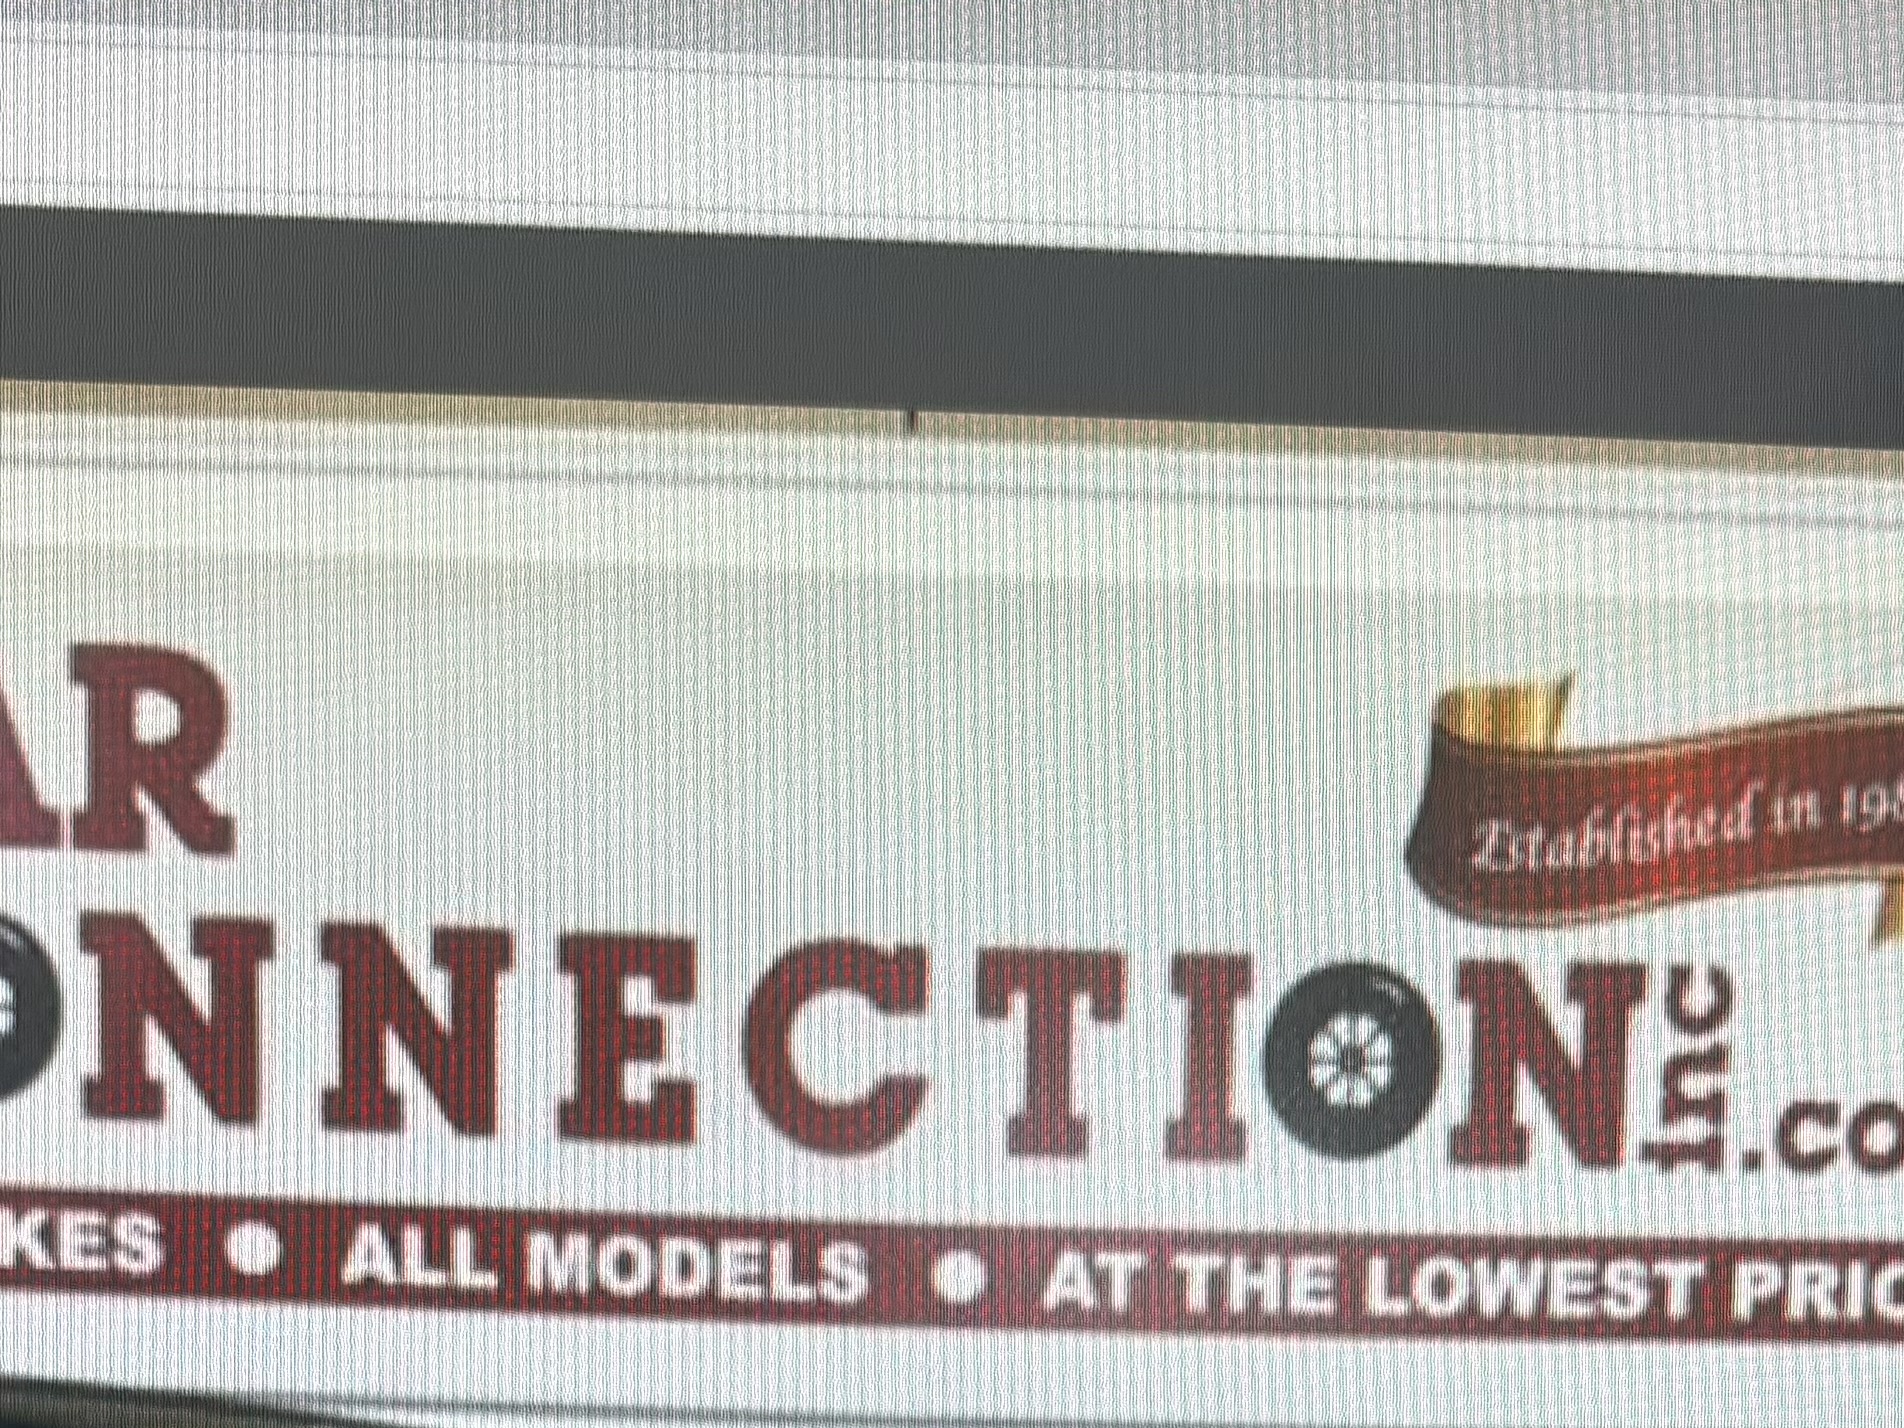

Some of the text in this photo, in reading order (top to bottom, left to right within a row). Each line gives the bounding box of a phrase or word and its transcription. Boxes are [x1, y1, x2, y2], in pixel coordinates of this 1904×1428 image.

[1471, 791, 1754, 874] Established
[1773, 783, 1822, 834] in
[342, 1220, 498, 1289] ALL
[525, 1230, 869, 1305] MODELS
[1043, 1250, 1146, 1311] AT
[1174, 1253, 1336, 1314] THE
[1367, 1256, 1705, 1319] LOWEST
